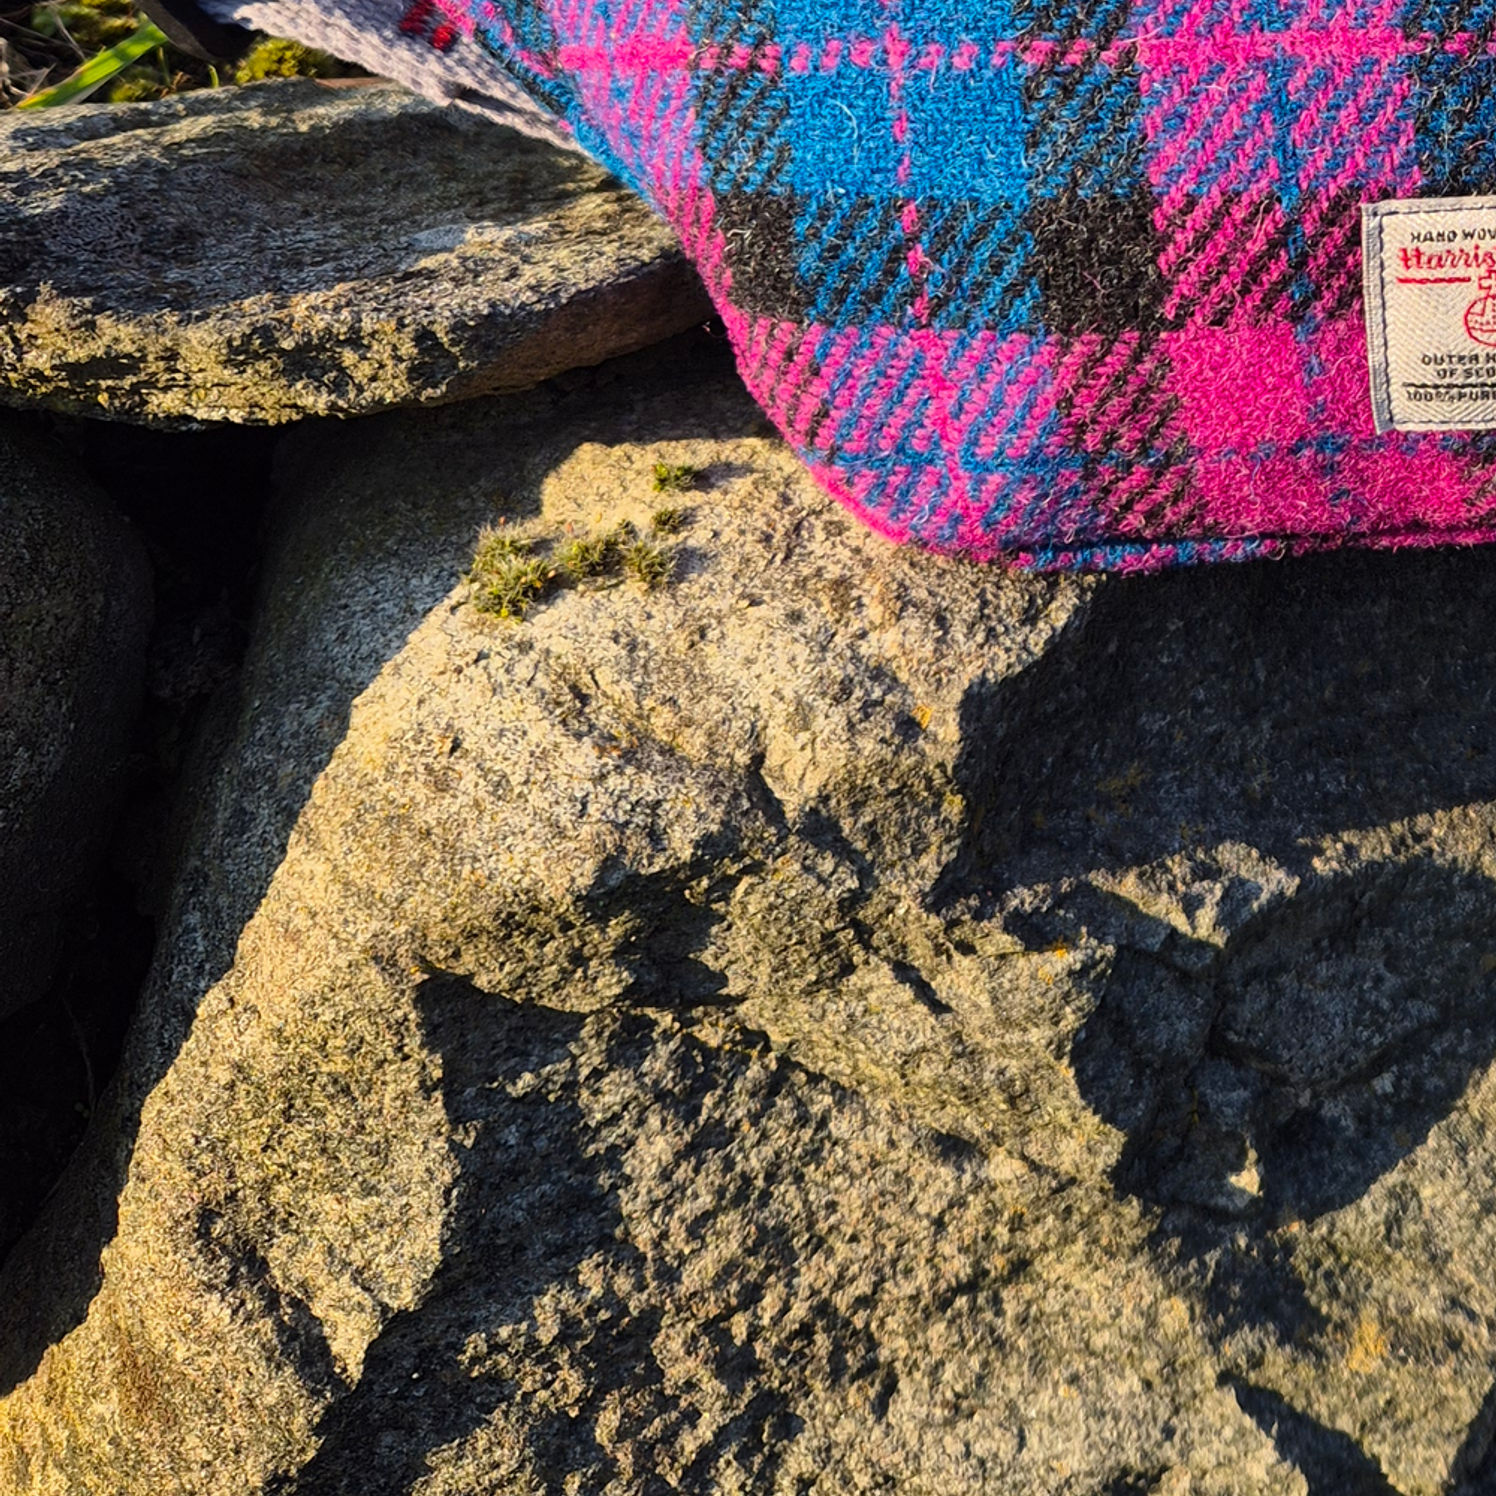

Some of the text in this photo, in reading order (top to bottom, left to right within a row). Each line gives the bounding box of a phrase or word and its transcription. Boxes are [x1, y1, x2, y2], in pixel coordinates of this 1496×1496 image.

[1411, 230, 1458, 242] HAND
[1398, 244, 1496, 270] Harris
[1421, 353, 1480, 365] OUTER
[1436, 367, 1459, 378] OF
